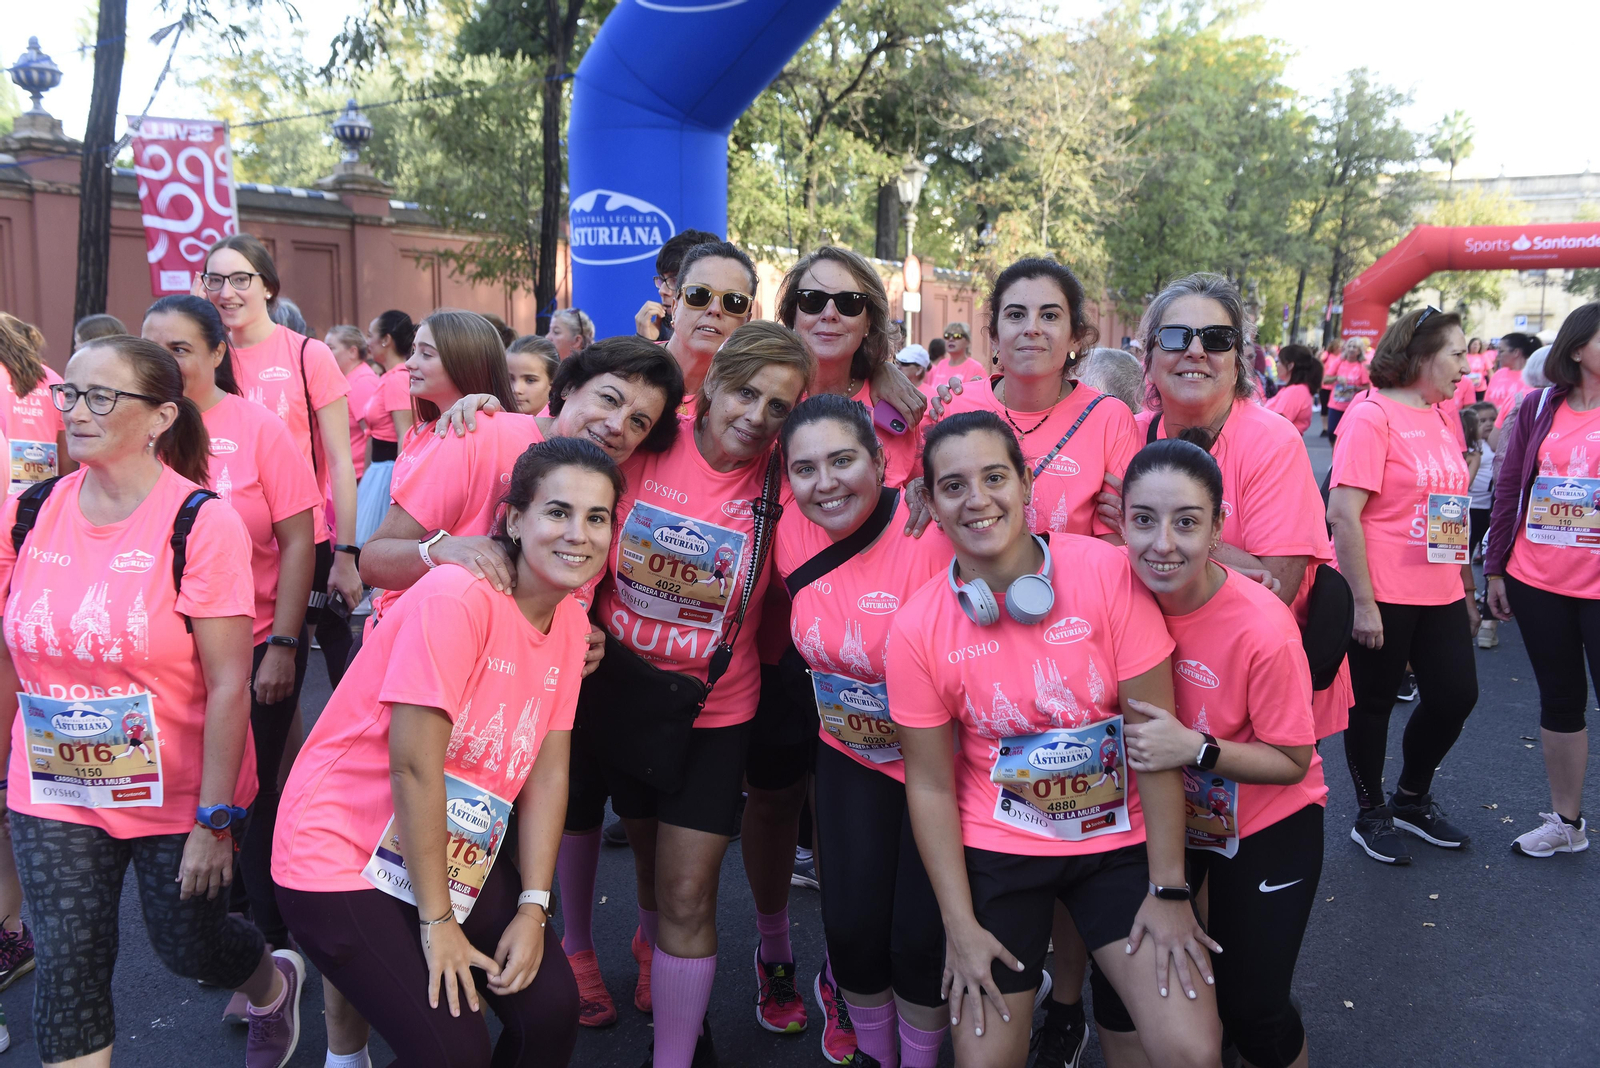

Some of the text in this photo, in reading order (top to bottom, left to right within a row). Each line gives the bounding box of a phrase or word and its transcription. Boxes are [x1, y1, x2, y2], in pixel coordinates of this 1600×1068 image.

[609, 214, 659, 224] LECHERA
[1464, 233, 1600, 254] Sports Santande
[30, 397, 42, 406] LA
[12, 406, 44, 417] MUJER
[24, 462, 44, 474] 016
[644, 479, 688, 505] OYSHO
[1552, 489, 1585, 498] ASTURIANA
[1550, 503, 1584, 517] 016
[1441, 521, 1460, 534] 016
[656, 530, 704, 553] ASTURIANA
[1531, 533, 1556, 541] OYSHO
[649, 553, 699, 584] 016
[655, 579, 681, 594] 4022
[621, 587, 649, 610] OYSHO
[631, 581, 702, 607] CARRERA DE LA MUJER
[860, 599, 897, 609] ASTURIANA
[688, 612, 709, 620] Santander
[948, 640, 1000, 664] OYSHO
[487, 656, 516, 676] YSHO
[1178, 664, 1216, 687] ASTURIANA
[843, 692, 884, 710] ASTURIANA
[54, 717, 108, 731] ASTURIANA
[847, 713, 891, 734] 016
[845, 741, 870, 750] CARRERA
[862, 736, 887, 744] 4020
[58, 742, 114, 763] 016
[1033, 752, 1088, 765] ASTURIANA
[75, 767, 103, 777] 1150
[54, 775, 83, 785] CARRERA
[105, 777, 132, 786] MUJER
[1033, 774, 1089, 798] 016
[43, 787, 82, 799] OYSHO
[122, 790, 148, 798] Santander
[1025, 801, 1053, 819] CARRERA
[1077, 805, 1101, 817] MUJER
[1047, 799, 1076, 811] 4880
[1007, 807, 1048, 828] OYSHO
[447, 831, 480, 865] 16
[452, 881, 471, 895] MUJER
